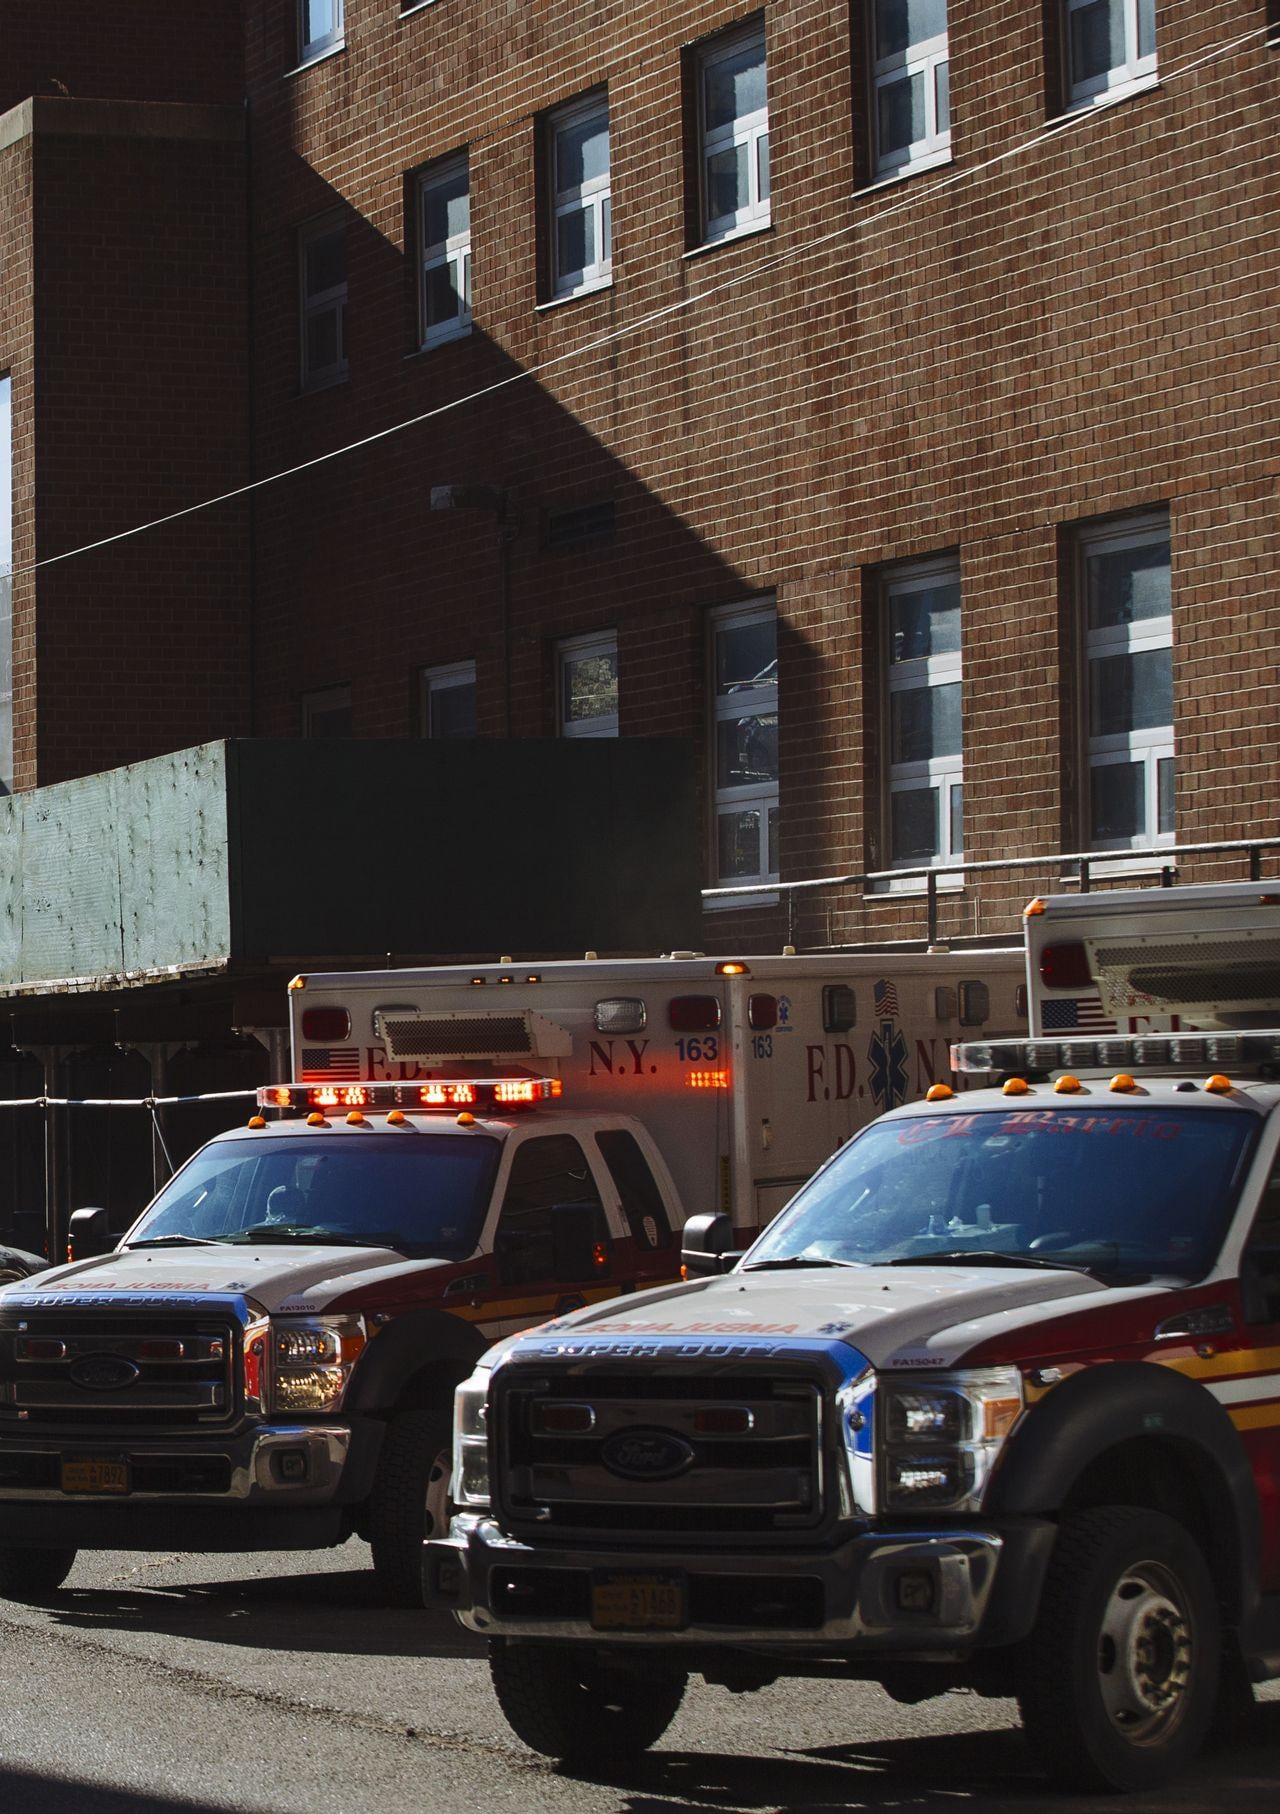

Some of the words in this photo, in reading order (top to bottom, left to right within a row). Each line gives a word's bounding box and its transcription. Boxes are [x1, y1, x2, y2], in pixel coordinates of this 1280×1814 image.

[588, 1039, 657, 1076] N.Y.
[674, 1036, 718, 1062] 163
[751, 1034, 773, 1059] 163
[806, 1043, 864, 1102] F.D.
[993, 1110, 1184, 1141] Barrio
[21, 1294, 113, 1307] SUPER
[125, 1293, 208, 1307] DUTY
[540, 1341, 663, 1358] SUPER
[677, 1341, 788, 1358] DUTY
